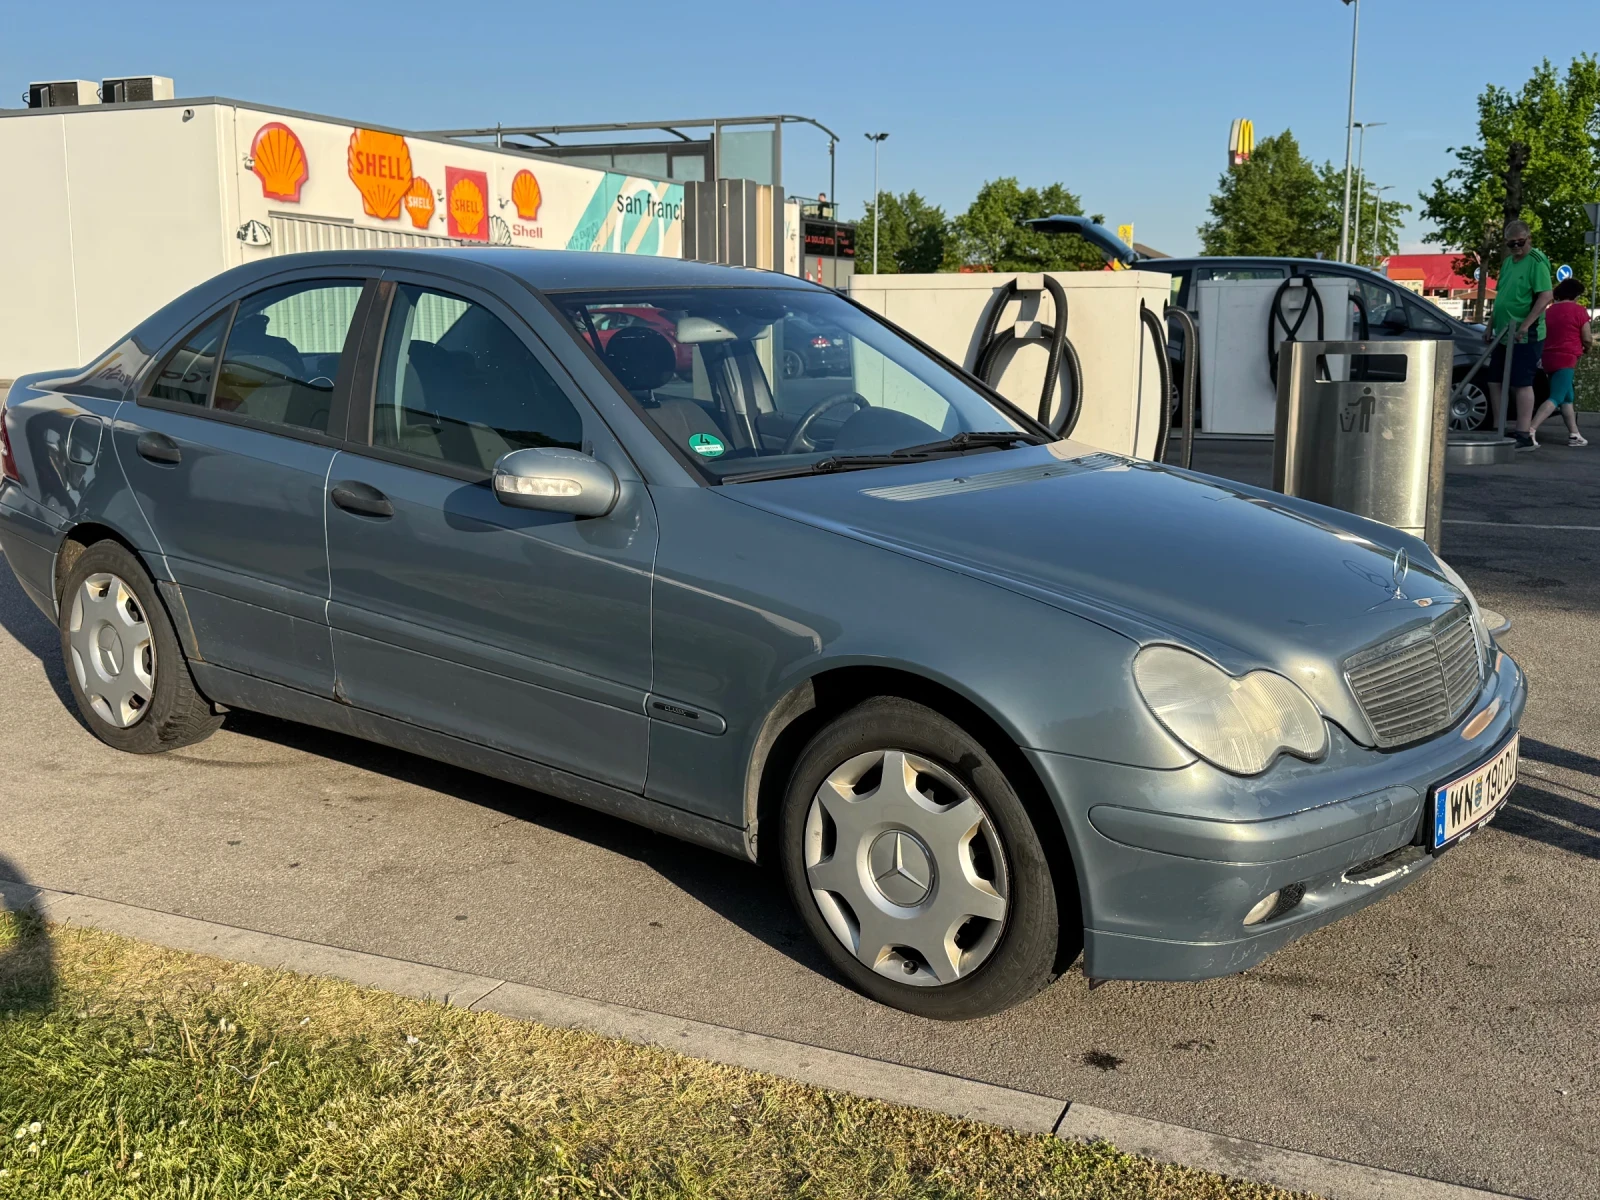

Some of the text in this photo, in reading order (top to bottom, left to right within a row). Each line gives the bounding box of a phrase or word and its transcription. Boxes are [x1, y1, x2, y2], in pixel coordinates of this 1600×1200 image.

[355, 151, 405, 181] SHELL
[407, 195, 432, 210] SHELL
[454, 198, 480, 214] SHELL
[616, 194, 642, 216] san
[512, 224, 543, 239] Shell
[700, 434, 710, 445] 4
[1450, 779, 1475, 829] WN
[1437, 823, 1443, 837] A
